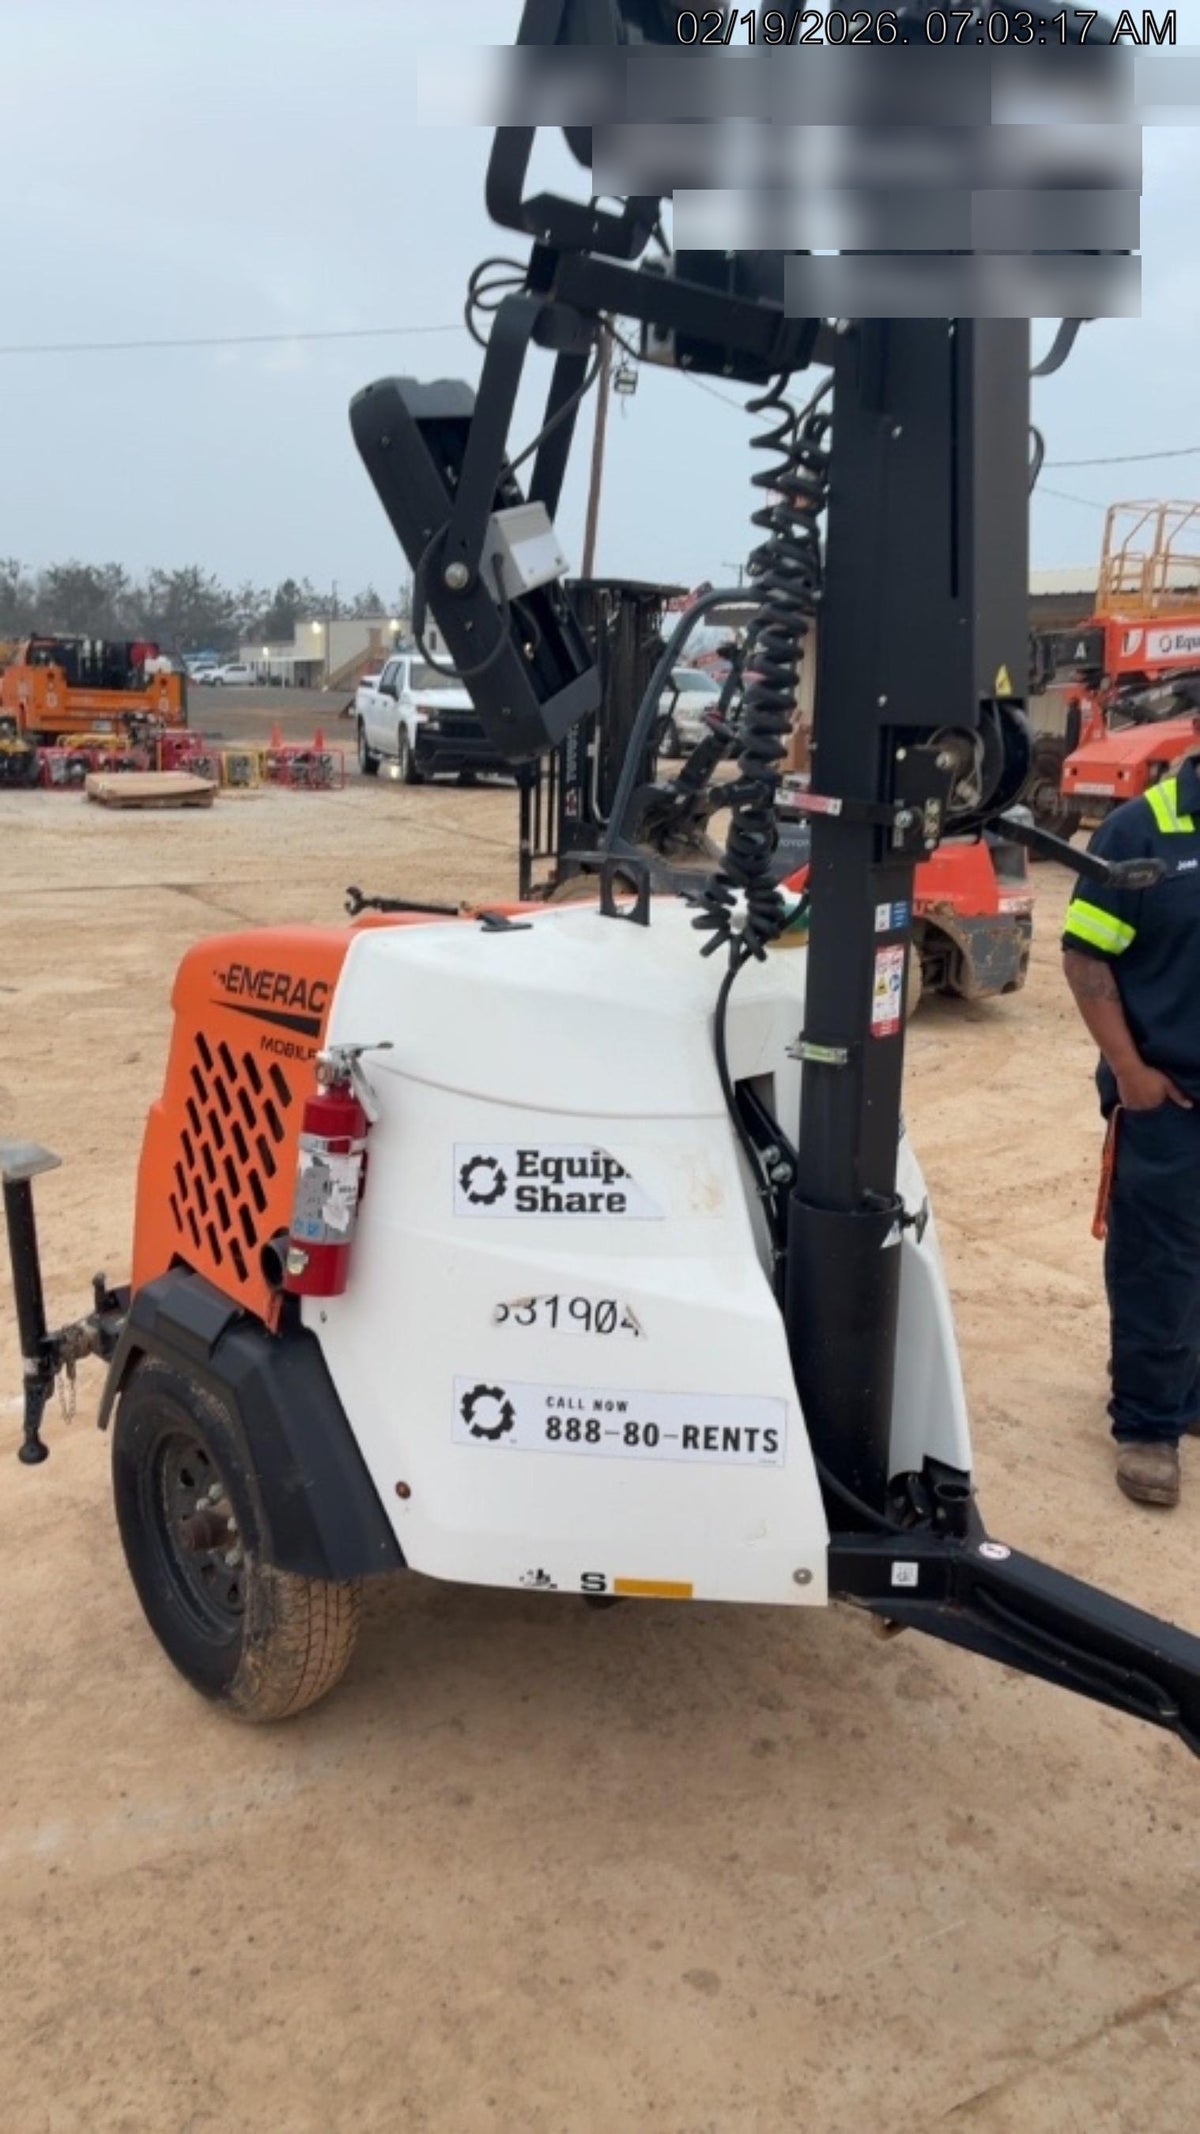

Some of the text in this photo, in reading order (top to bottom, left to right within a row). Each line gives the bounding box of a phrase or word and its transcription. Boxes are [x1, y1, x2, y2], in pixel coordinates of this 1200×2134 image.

[516, 1149, 631, 1185] Equip
[515, 1184, 627, 1213] Share
[546, 1395, 629, 1413] CALL NOW
[545, 1415, 779, 1454] 888-80-RENTS
